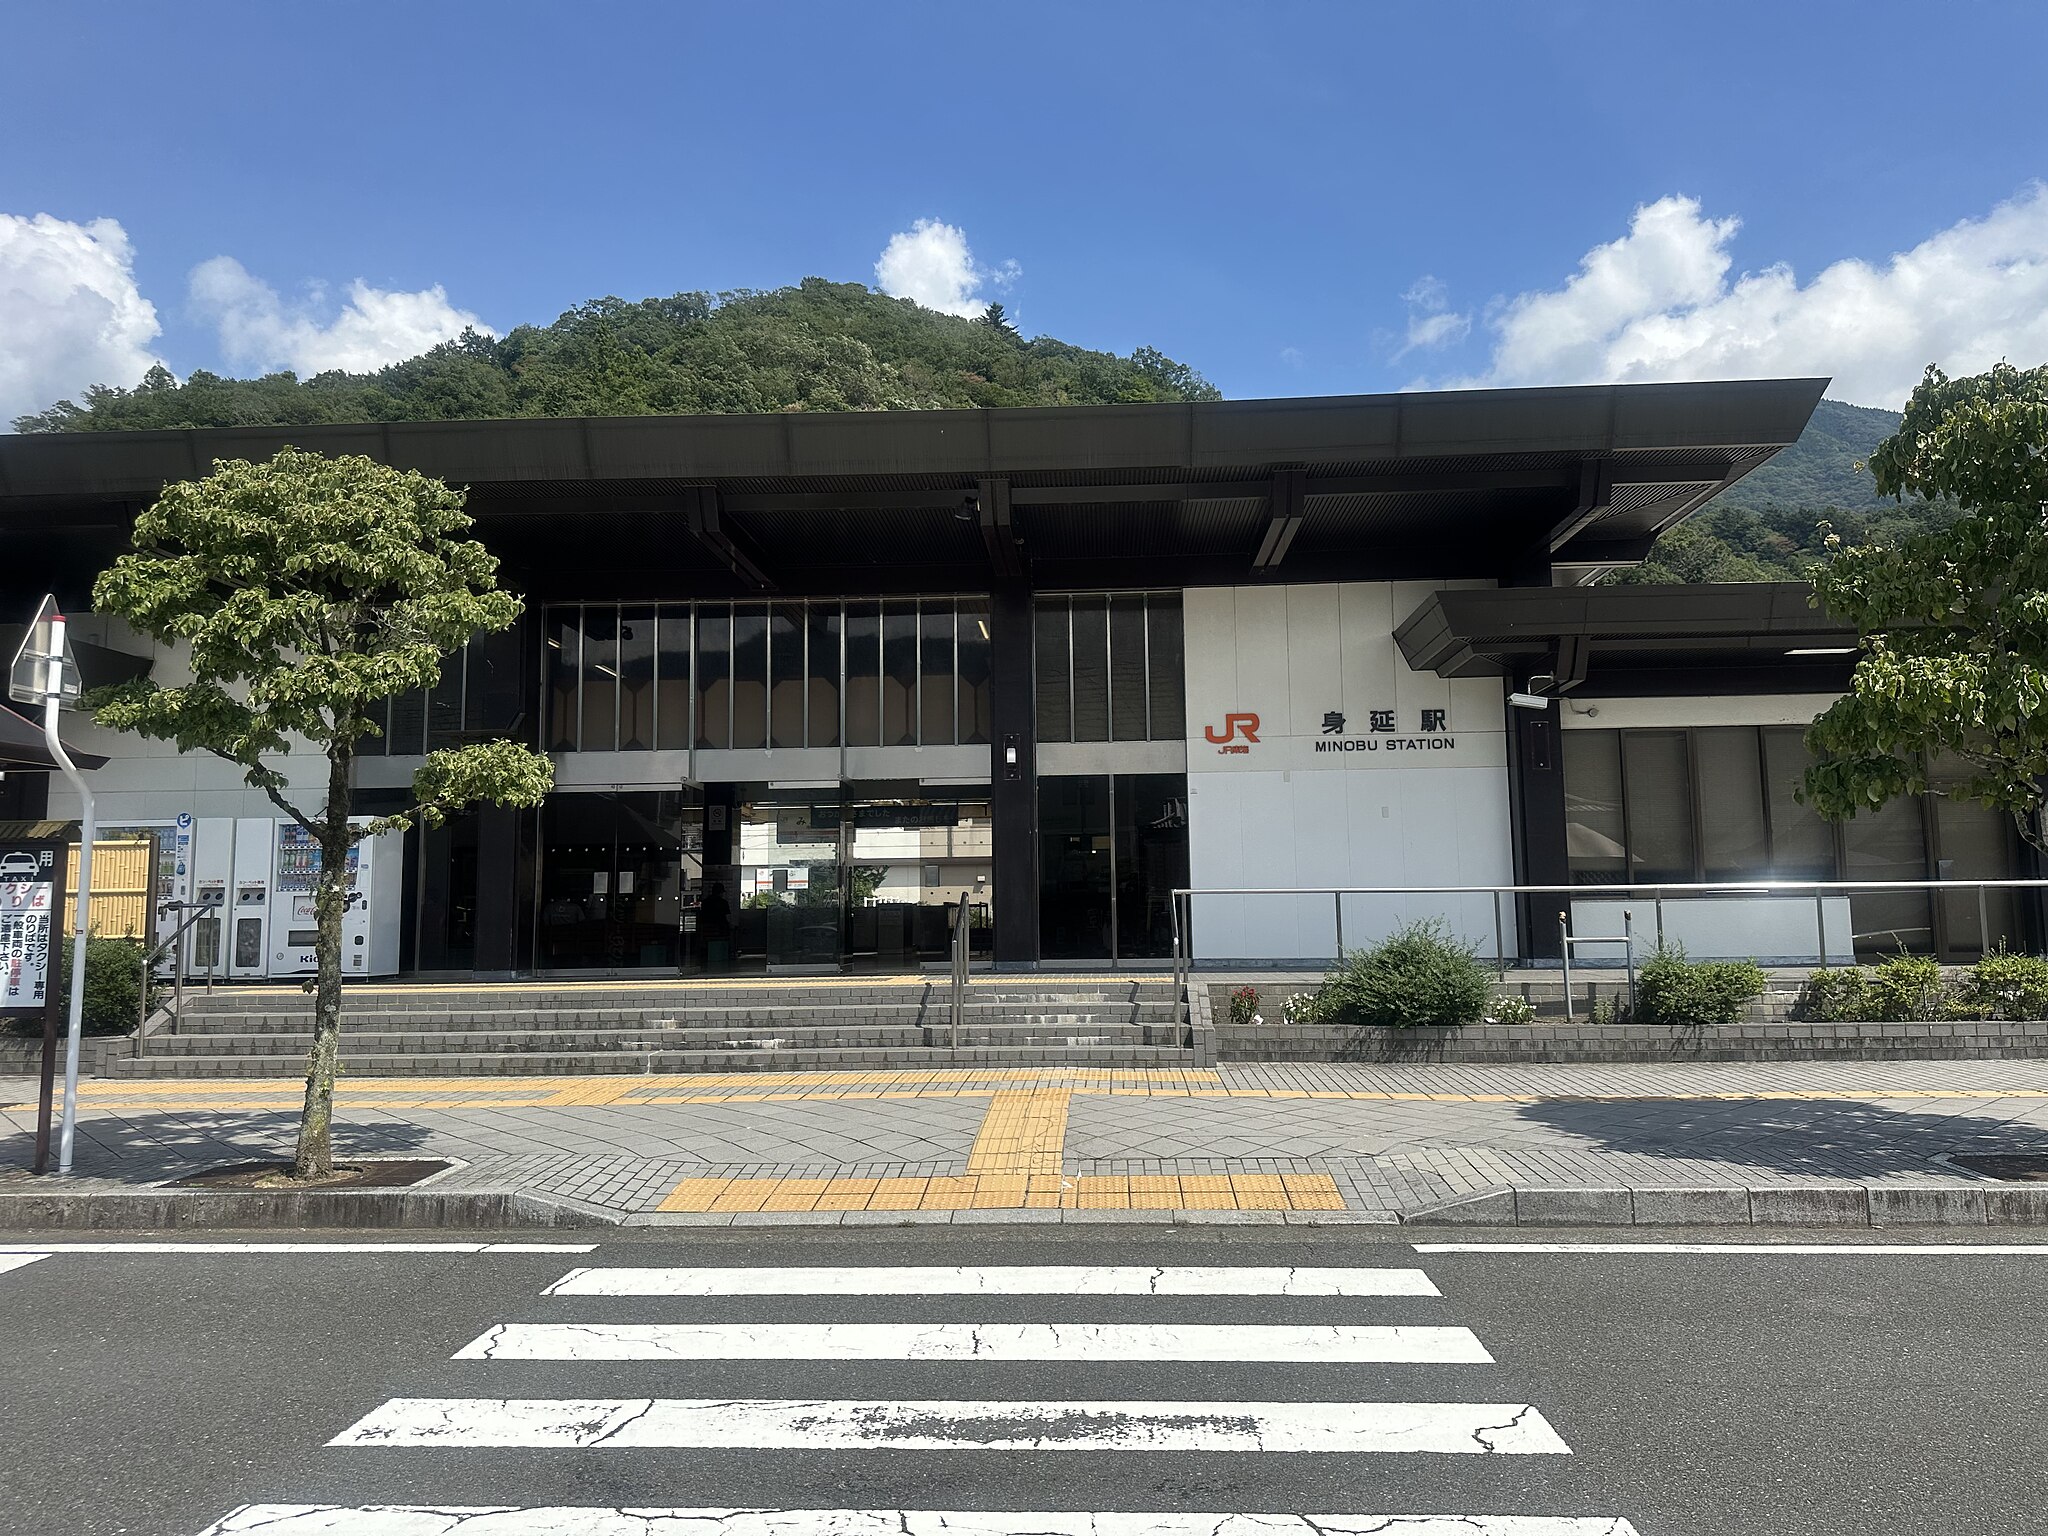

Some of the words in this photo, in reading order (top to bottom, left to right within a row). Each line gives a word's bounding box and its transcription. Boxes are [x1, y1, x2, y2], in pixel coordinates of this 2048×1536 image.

[1205, 713, 1260, 743] JR
[1321, 709, 1447, 734] 身延駅
[1315, 740, 1378, 752] MINOBU
[1386, 738, 1455, 750] STATION
[0, 883, 48, 895] クシー
[0, 895, 45, 908] りば
[24, 914, 38, 967] のりばです。
[33, 914, 50, 1000] 当所はタクシー専用
